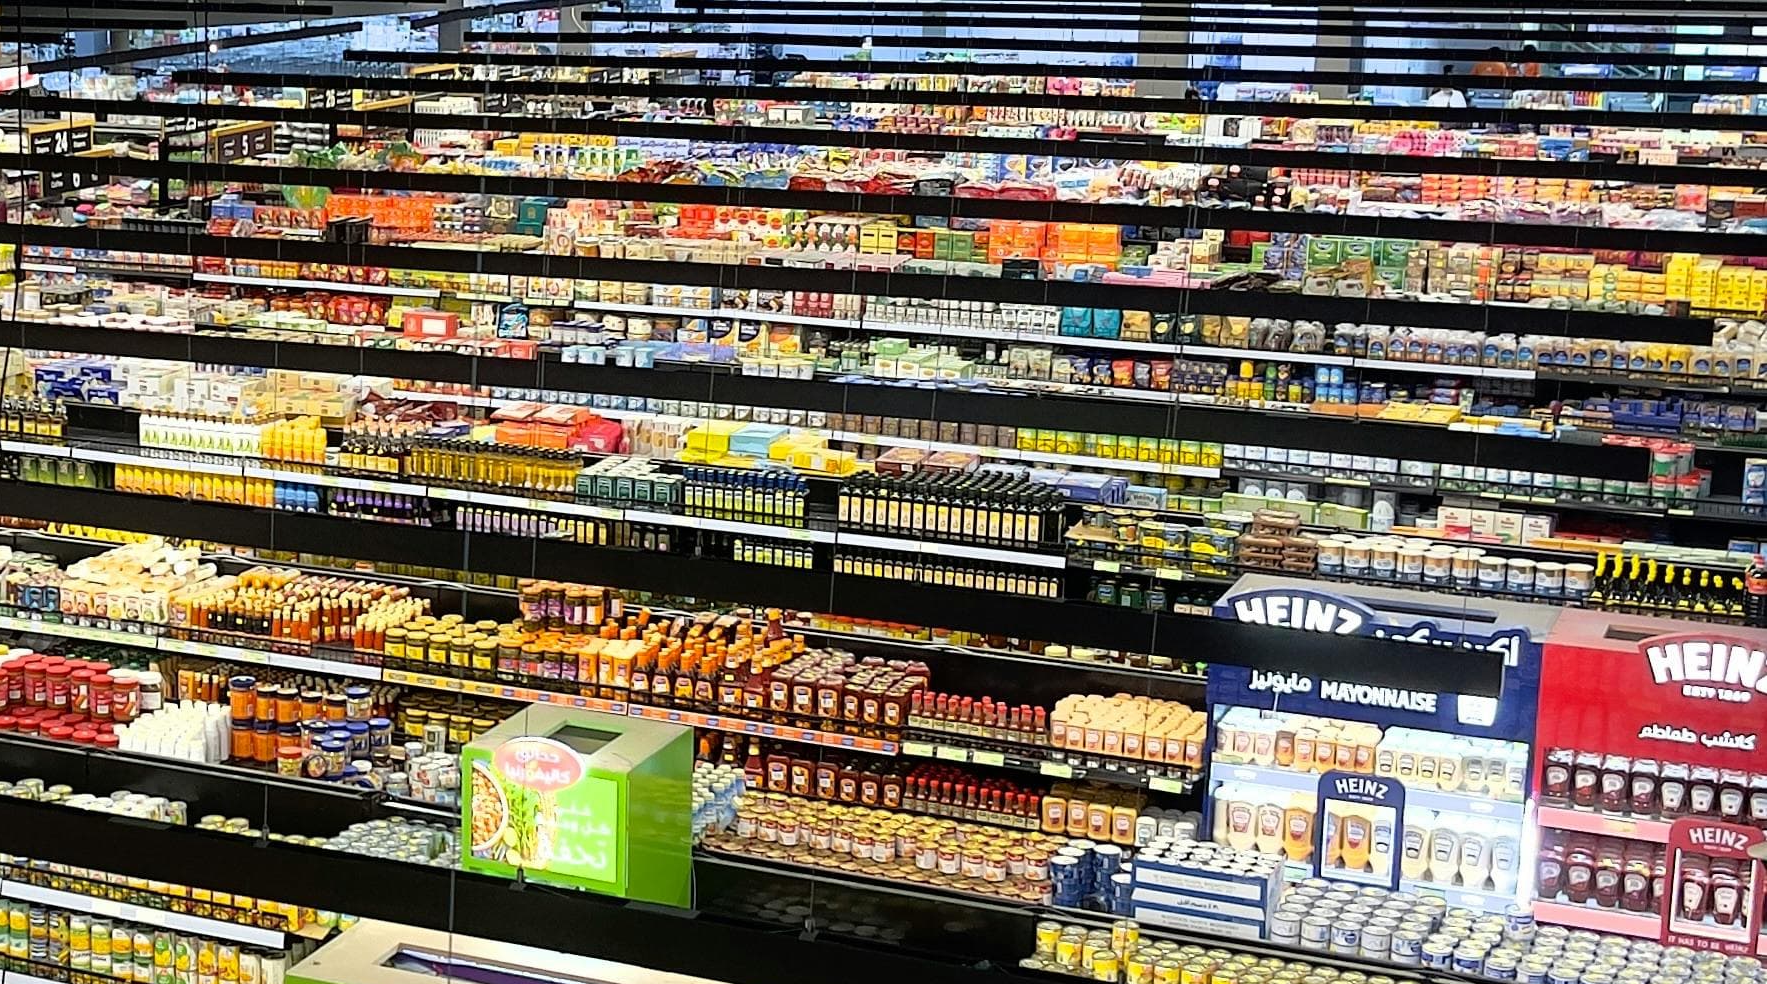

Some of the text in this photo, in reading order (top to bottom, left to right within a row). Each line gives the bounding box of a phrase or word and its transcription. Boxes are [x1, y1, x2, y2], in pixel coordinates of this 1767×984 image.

[55, 131, 68, 154] 24
[242, 135, 249, 156] 5
[1235, 596, 1362, 635] HEINZ
[1646, 642, 1767, 695] HEIN
[1320, 680, 1437, 713] MAYONNAISE
[1638, 724, 1697, 743] طماطم
[1335, 777, 1389, 800] HEINZ
[1689, 828, 1749, 851] HEINZ
[1697, 938, 1709, 949] TO
